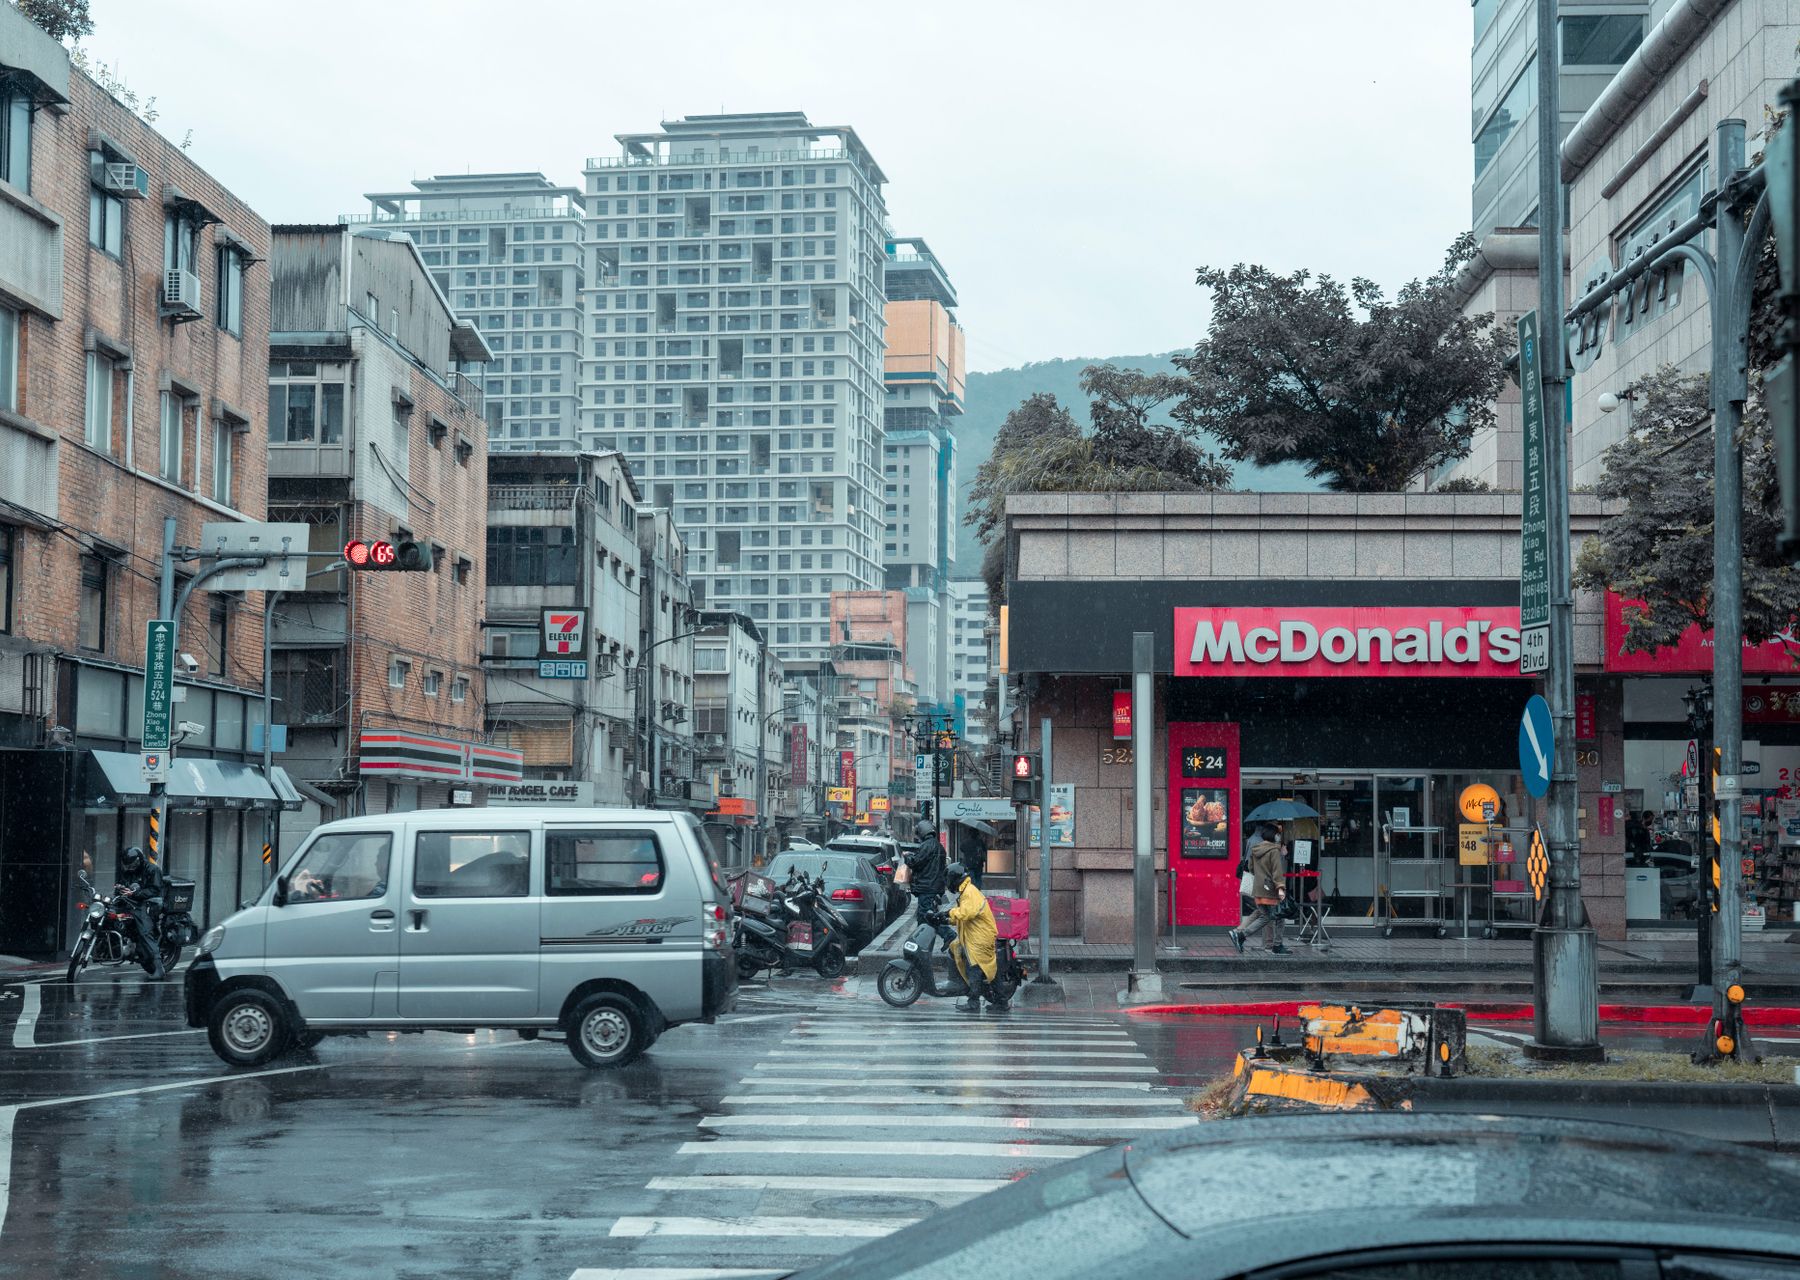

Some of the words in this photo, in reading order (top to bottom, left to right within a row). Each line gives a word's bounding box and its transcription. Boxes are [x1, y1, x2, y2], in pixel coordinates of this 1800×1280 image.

[1525, 367, 1540, 518] 忠孝東路五段
[1523, 520, 1546, 535] Zhong
[1523, 537, 1540, 550] Xiao
[377, 545, 394, 563] 65
[1523, 554, 1530, 567] E.
[1534, 551, 1546, 563] Rd.
[1523, 567, 1544, 582] Sec.5
[1522, 585, 1534, 597] 486
[1536, 581, 1548, 594] 485
[1522, 608, 1535, 621] 522
[1536, 605, 1548, 618] 617
[1190, 620, 1521, 663] McDonald's
[1527, 633, 1543, 648] 4th
[1522, 654, 1547, 669] Blvd.
[1205, 756, 1223, 769] 24
[508, 785, 547, 796] ANGEL
[549, 784, 579, 797] CAFÉ
[954, 802, 983, 817] Smile
[1461, 840, 1477, 851] $48
[174, 895, 189, 903] Uber
